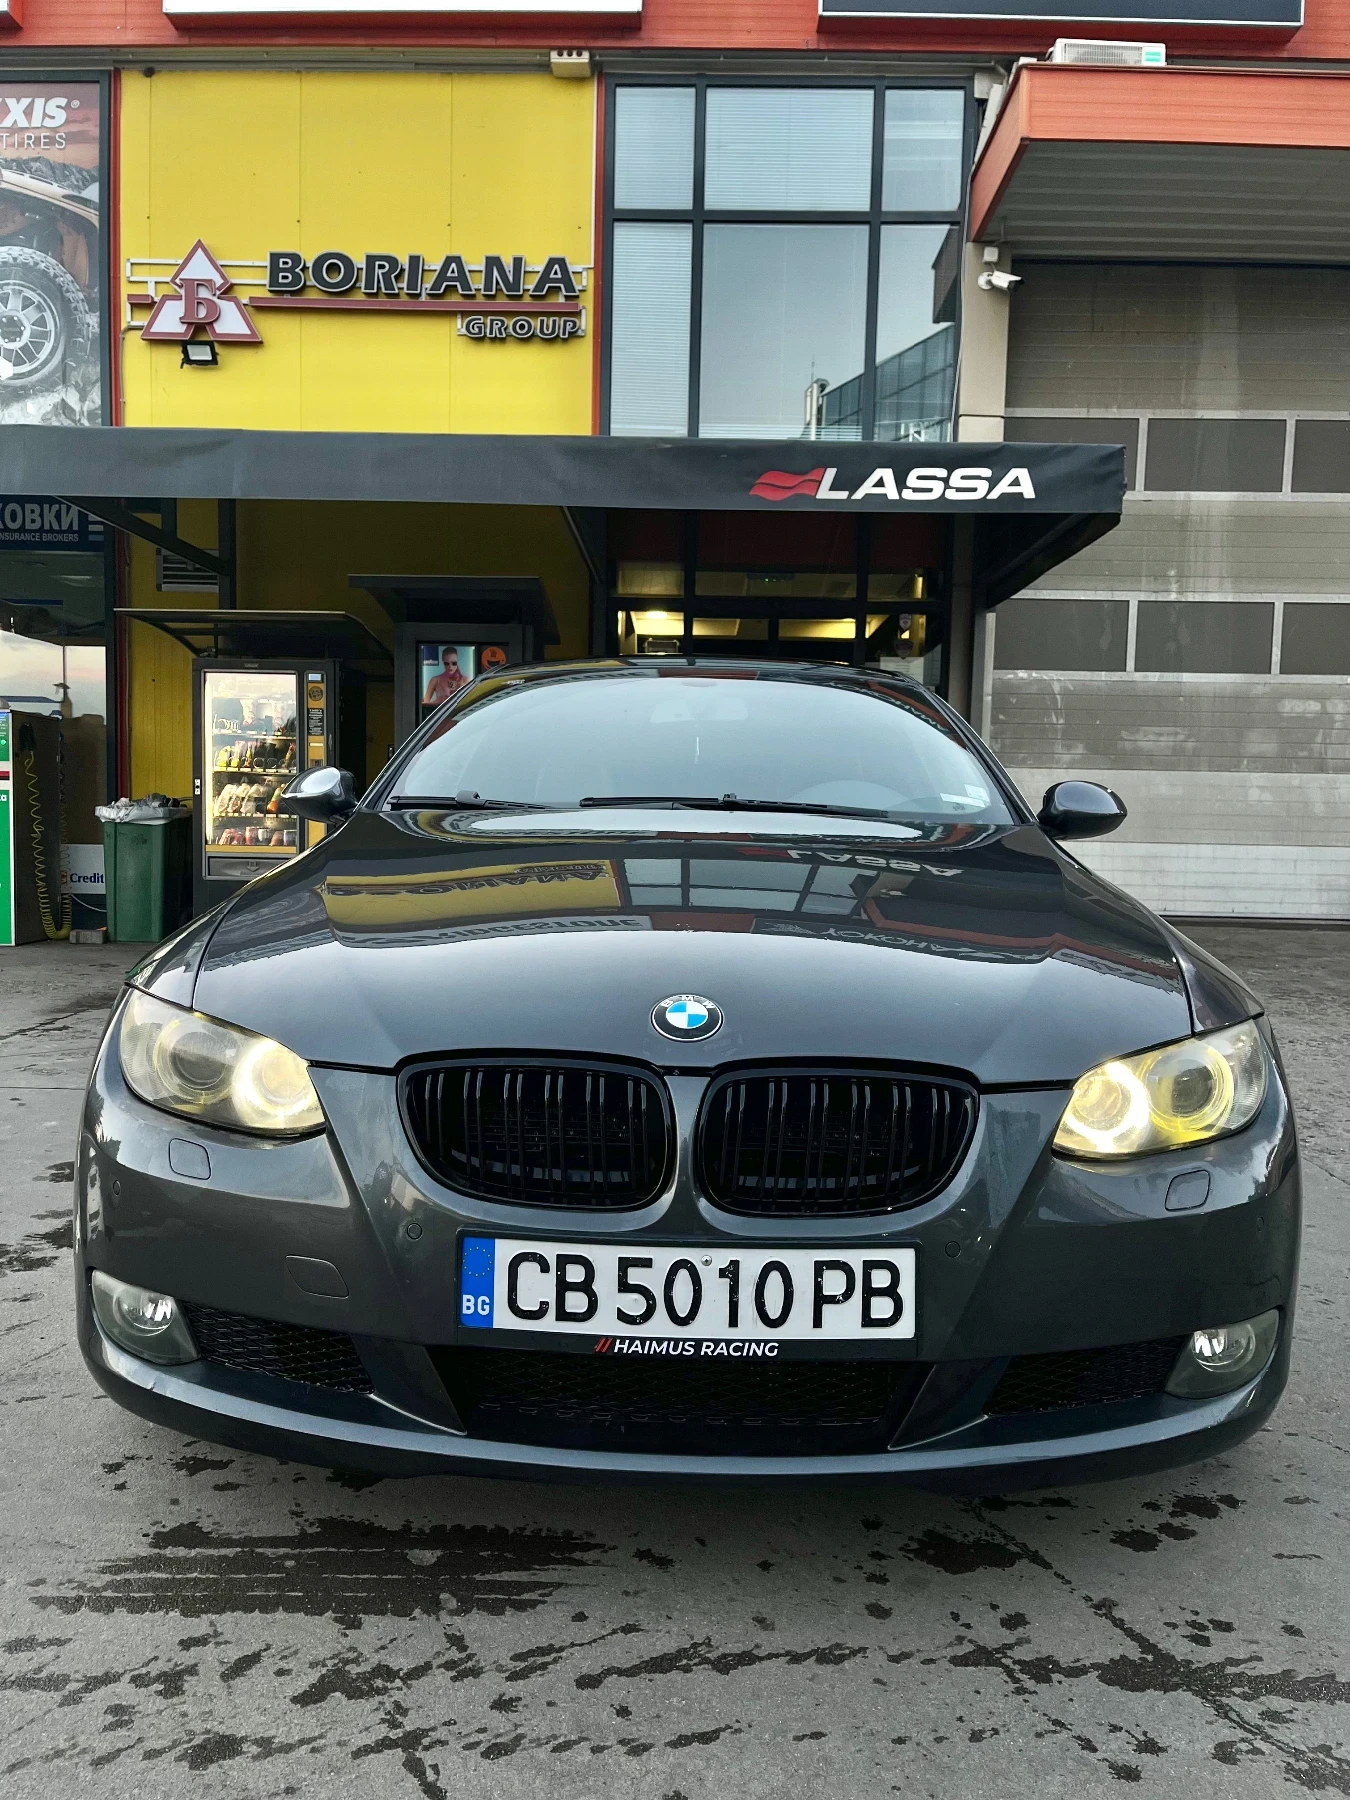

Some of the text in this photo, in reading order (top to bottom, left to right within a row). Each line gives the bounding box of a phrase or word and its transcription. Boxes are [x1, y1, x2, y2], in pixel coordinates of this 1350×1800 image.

[0, 132, 66, 149] TIRES
[267, 251, 580, 298] BORIANA
[463, 315, 580, 339] GROUP
[815, 467, 1036, 501] LASSA
[0, 503, 79, 530] ОВКИ
[42, 533, 79, 542] BROKERS
[70, 872, 105, 884] Credit
[661, 995, 716, 1009] BMW
[507, 1251, 905, 1329] CB 5010 PB
[462, 1294, 490, 1316] BG
[613, 1339, 780, 1357] HAIMUS RACING
